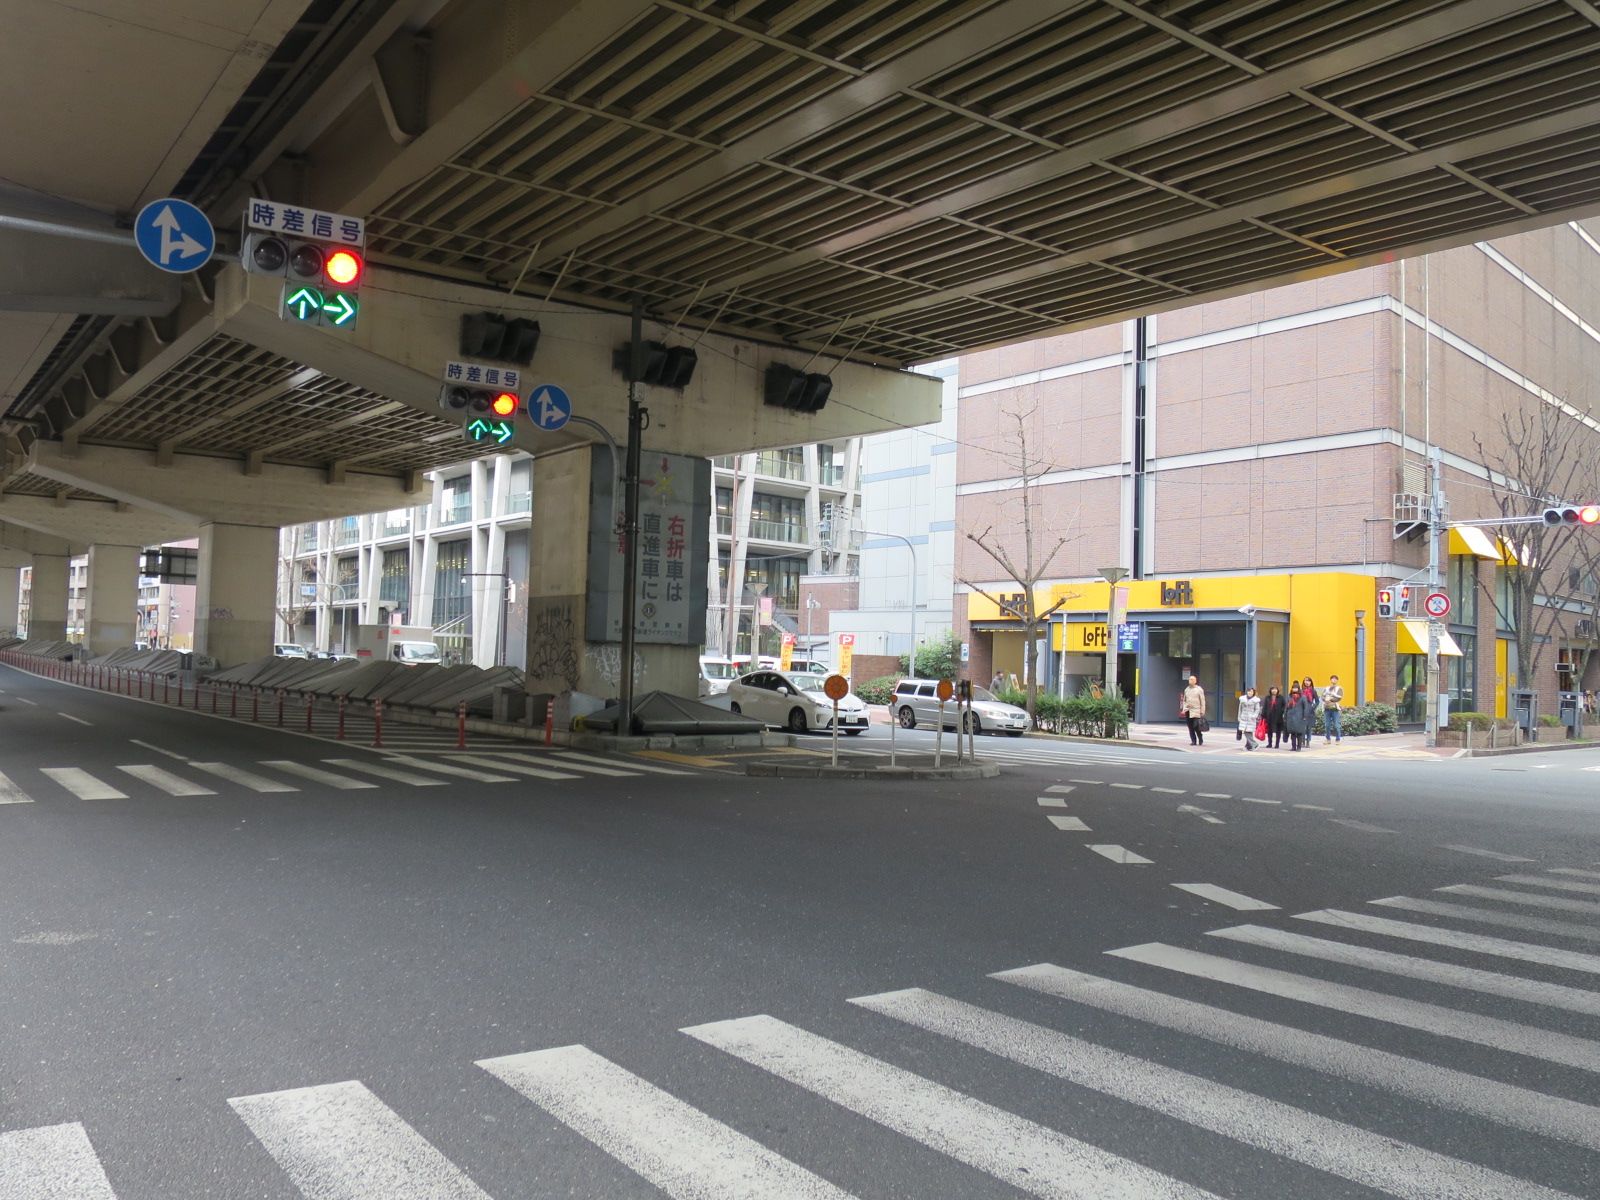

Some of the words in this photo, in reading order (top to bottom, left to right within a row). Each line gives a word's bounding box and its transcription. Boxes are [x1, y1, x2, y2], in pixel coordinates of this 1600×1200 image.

[252, 203, 361, 242] 時差信号
[447, 363, 518, 388] 時差信号
[641, 513, 661, 600] 直進車に
[666, 515, 686, 602] 右折車は
